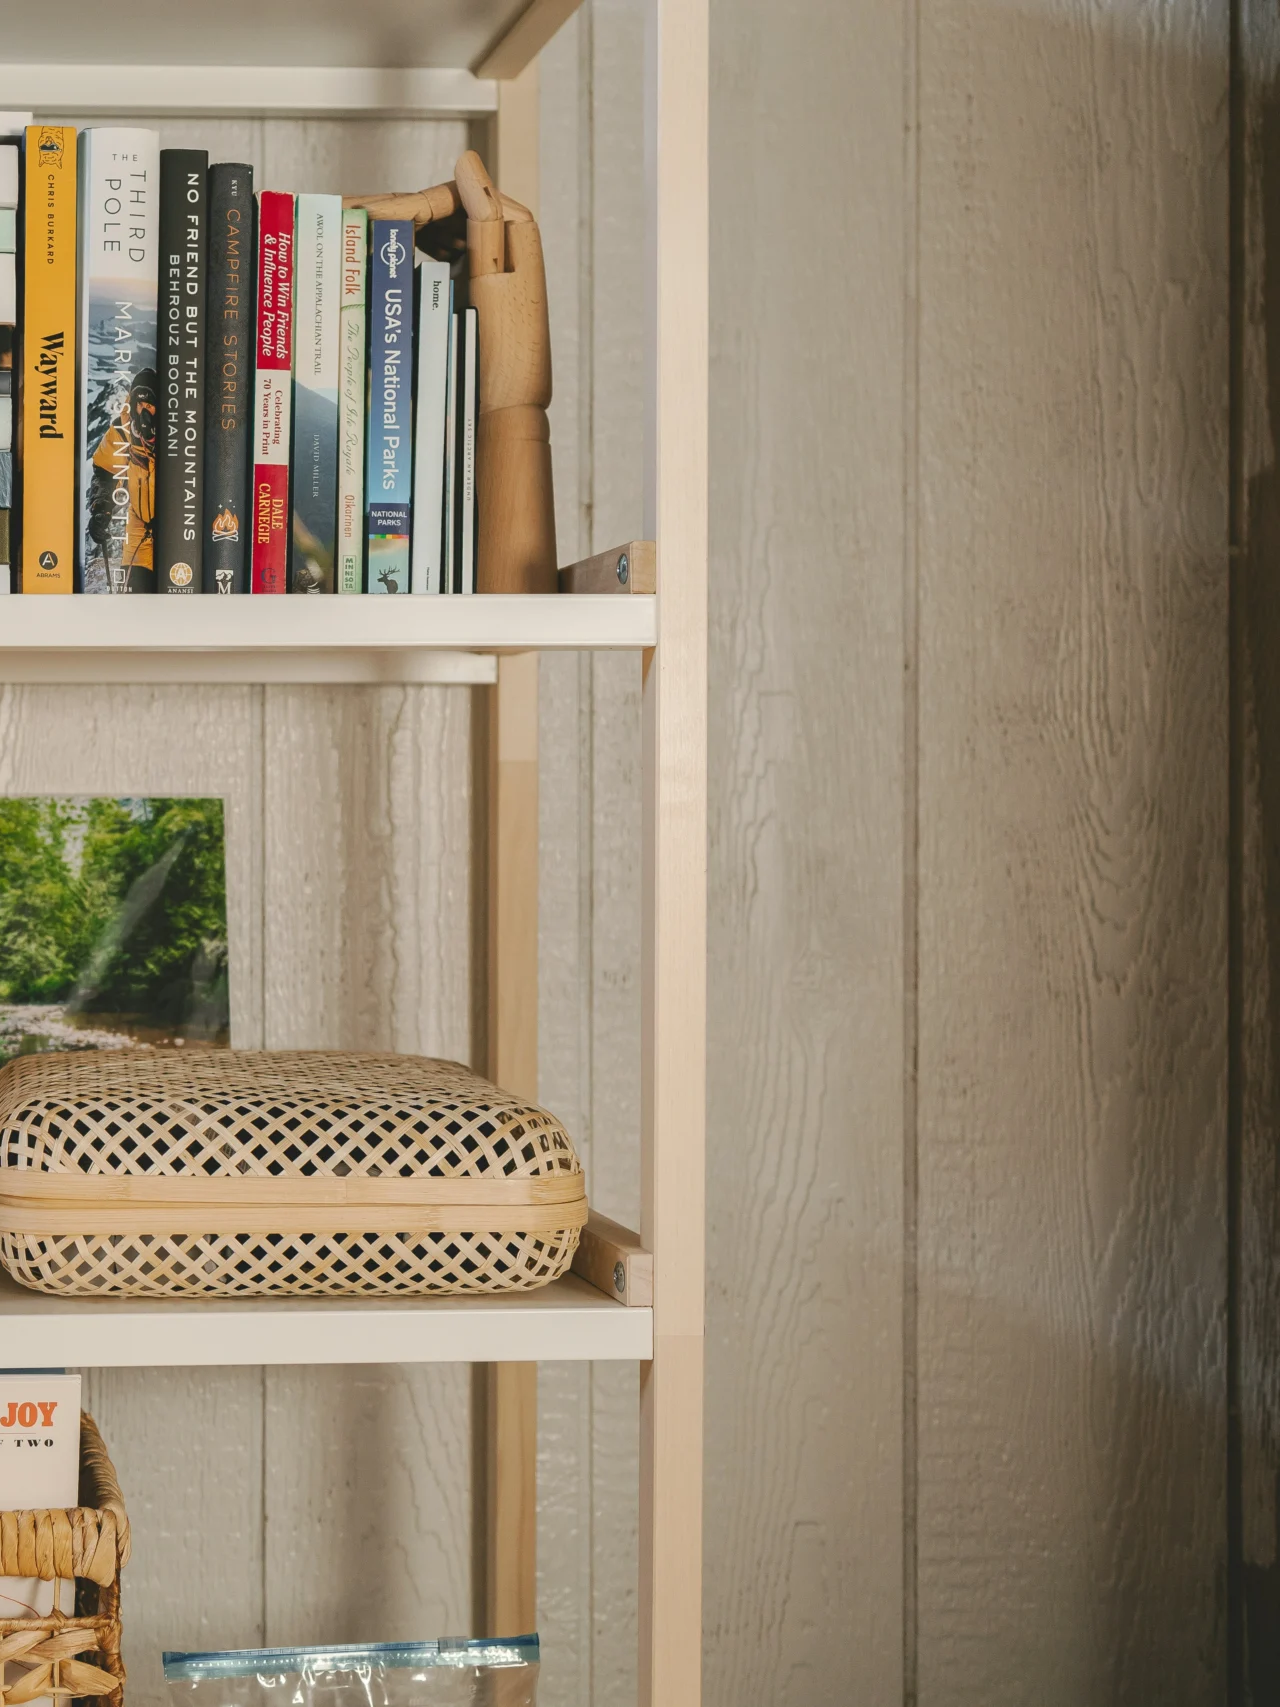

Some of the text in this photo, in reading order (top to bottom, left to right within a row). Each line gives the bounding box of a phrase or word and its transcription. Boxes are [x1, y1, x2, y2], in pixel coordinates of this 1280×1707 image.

[112, 154, 138, 162] THE
[104, 178, 121, 252] POLE
[129, 170, 147, 262] THIRD
[230, 180, 238, 196] KYU
[316, 243, 323, 258] ON
[345, 225, 361, 295] Island Folk
[388, 229, 399, 278] lonely planet
[221, 209, 241, 431] CAMPFIRE STORIES
[261, 234, 277, 356] & Influence People
[276, 232, 291, 359] How to Win Friends
[315, 280, 323, 345] APPALACHIAN
[432, 280, 442, 311] home.
[168, 254, 180, 457] BEHROUZ BOOCHANI
[183, 173, 199, 541] NO FRIEND BUT THE MOUNTAINS
[264, 378, 272, 390] 70
[34, 331, 64, 439] Wayward
[262, 391, 272, 419] Years
[342, 320, 360, 475] The People of Isle Royale
[382, 289, 402, 490] USA's National Parks
[112, 302, 133, 544] MARK SYNNOTT
[262, 432, 270, 455] Print
[272, 390, 284, 445] Celebrating
[467, 462, 471, 471] AN
[258, 483, 271, 544] CARNEGIE
[272, 498, 284, 530] DALE
[344, 495, 354, 538] Oikarinen
[0, 1402, 57, 1427] JOY
[14, 1438, 54, 1447] TWO
